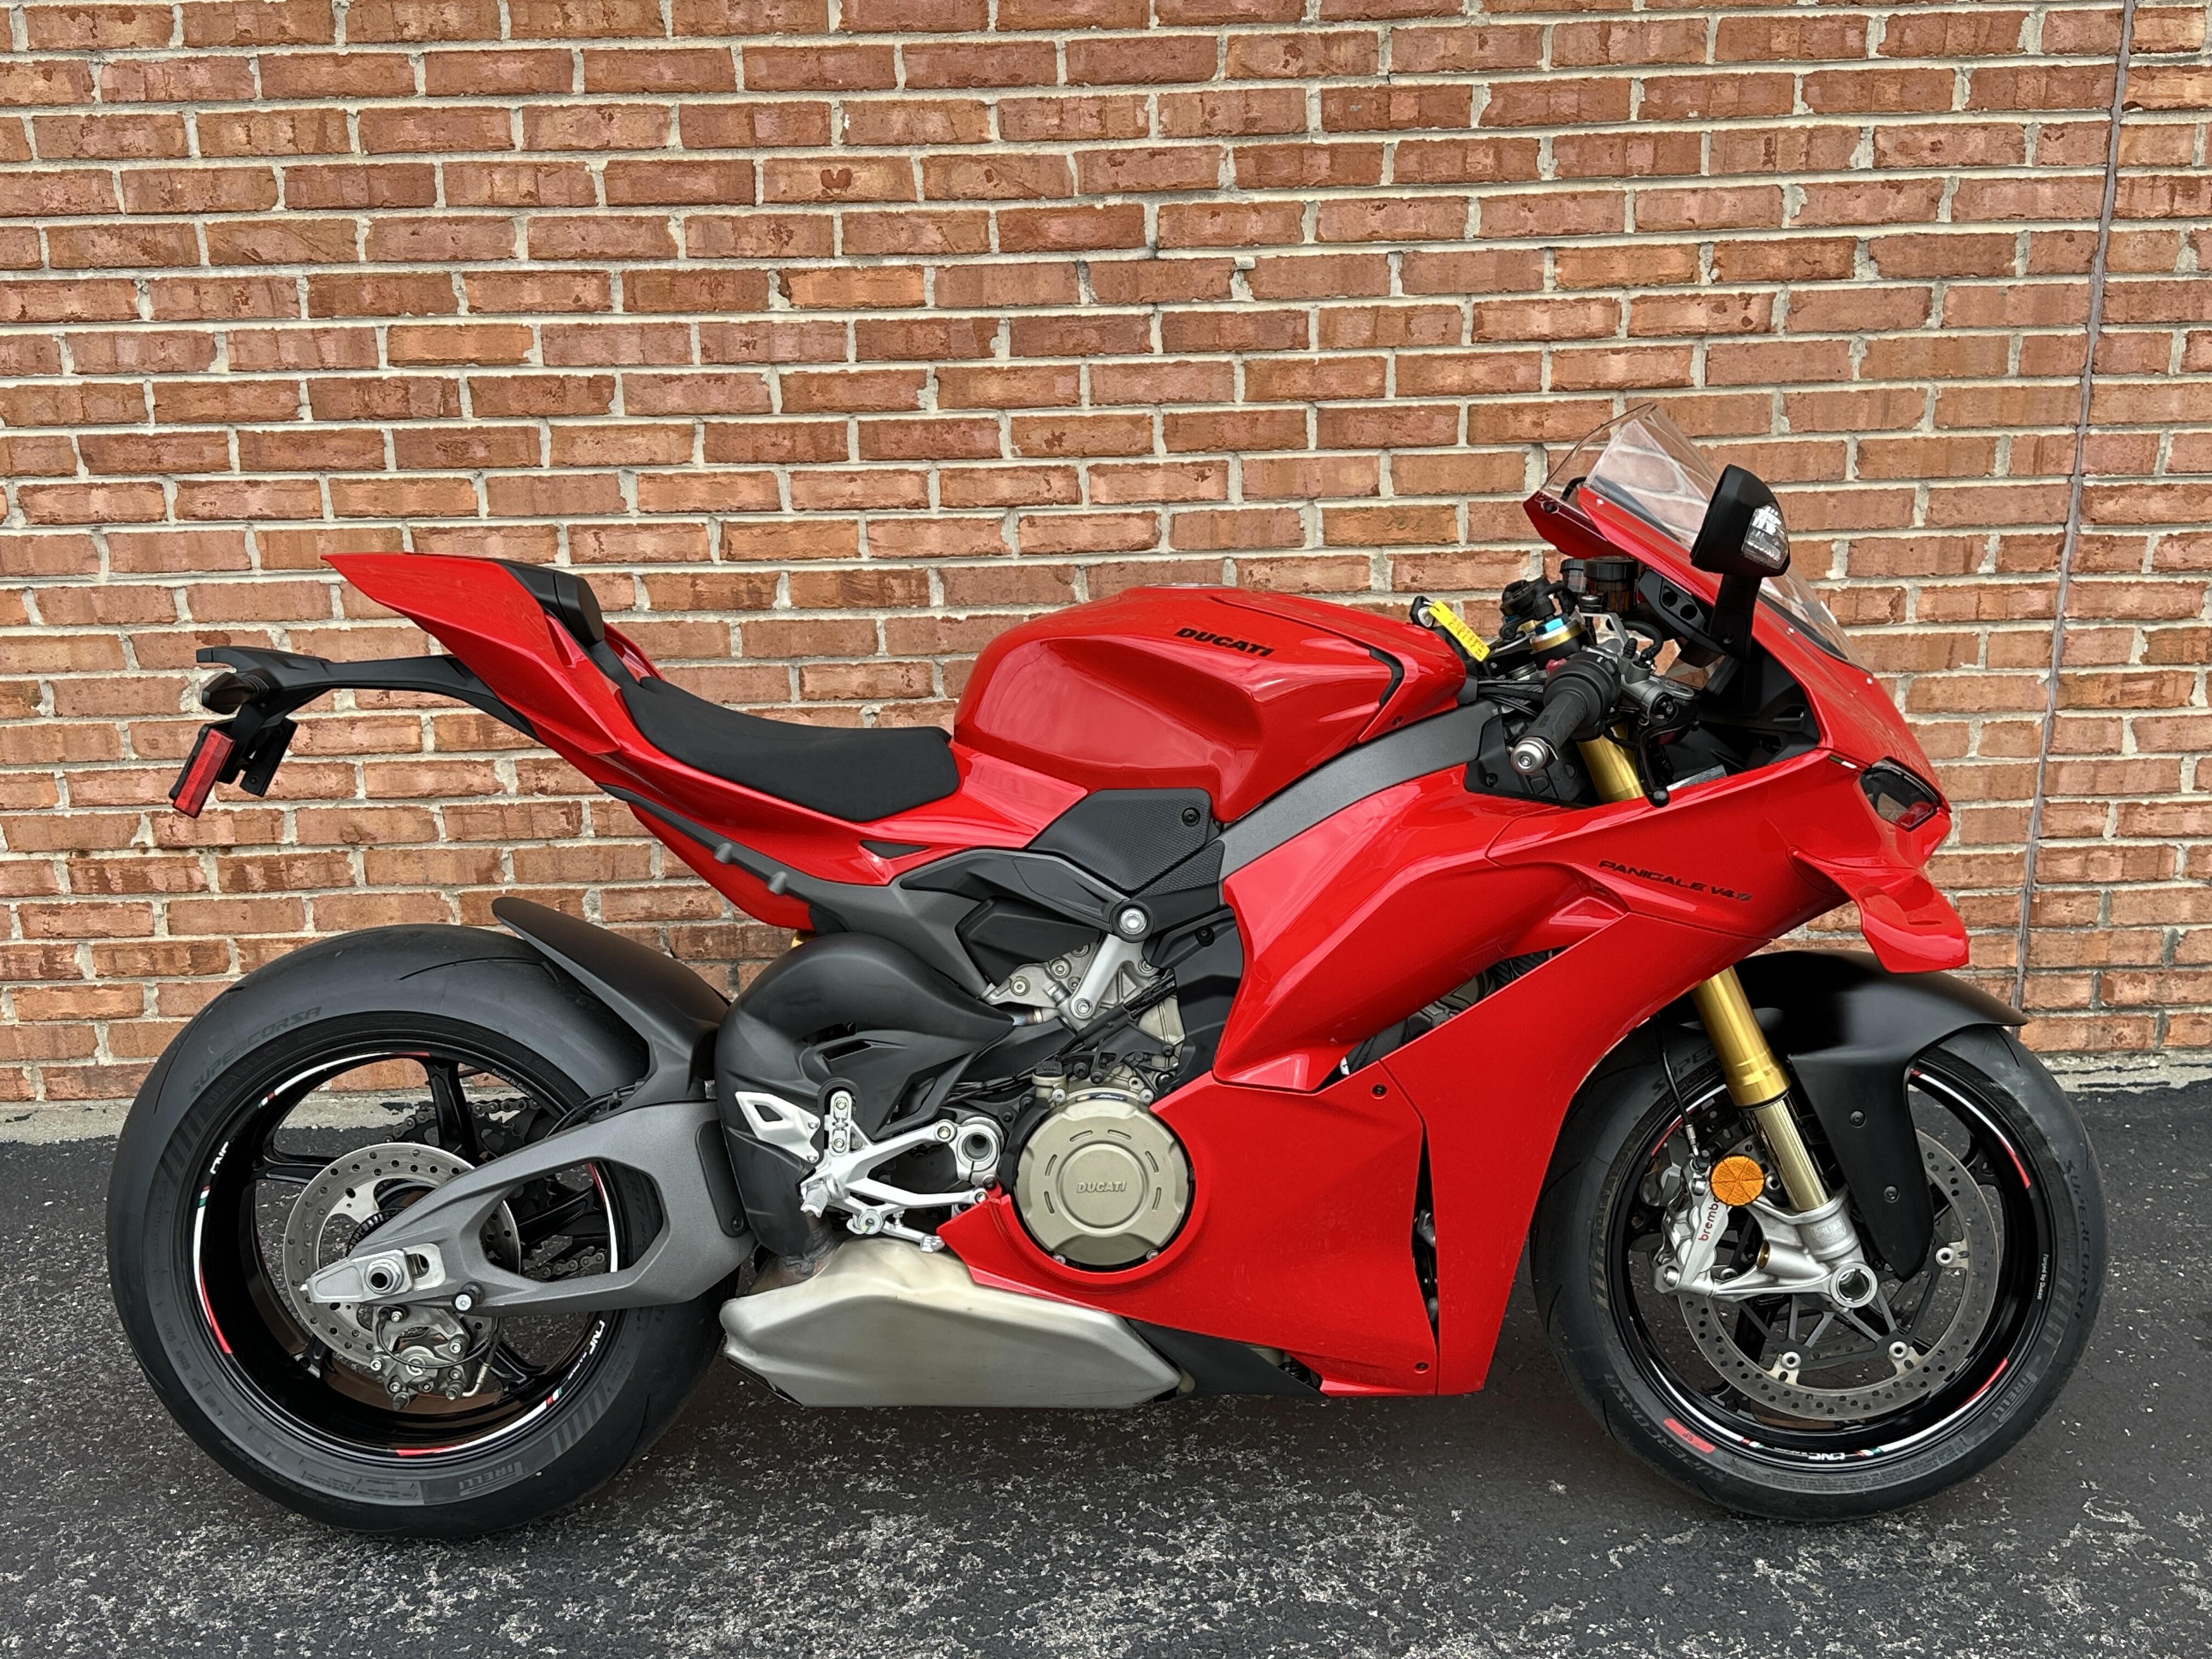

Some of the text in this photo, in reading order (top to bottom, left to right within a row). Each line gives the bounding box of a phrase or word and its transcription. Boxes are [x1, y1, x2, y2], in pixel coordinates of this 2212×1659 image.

[1173, 628, 1276, 657] DUCATI
[1598, 860, 1707, 891] PANIGALE
[190, 1006, 321, 1098] SUPERCORSA
[1076, 1181, 1127, 1193] DUCATI
[2063, 1159, 2089, 1320] SUPERCORSA
[1991, 1371, 2038, 1423] PIRELLI
[1604, 1374, 1728, 1482] SUPERCORSA
[458, 1460, 523, 1497] PIRELLI
